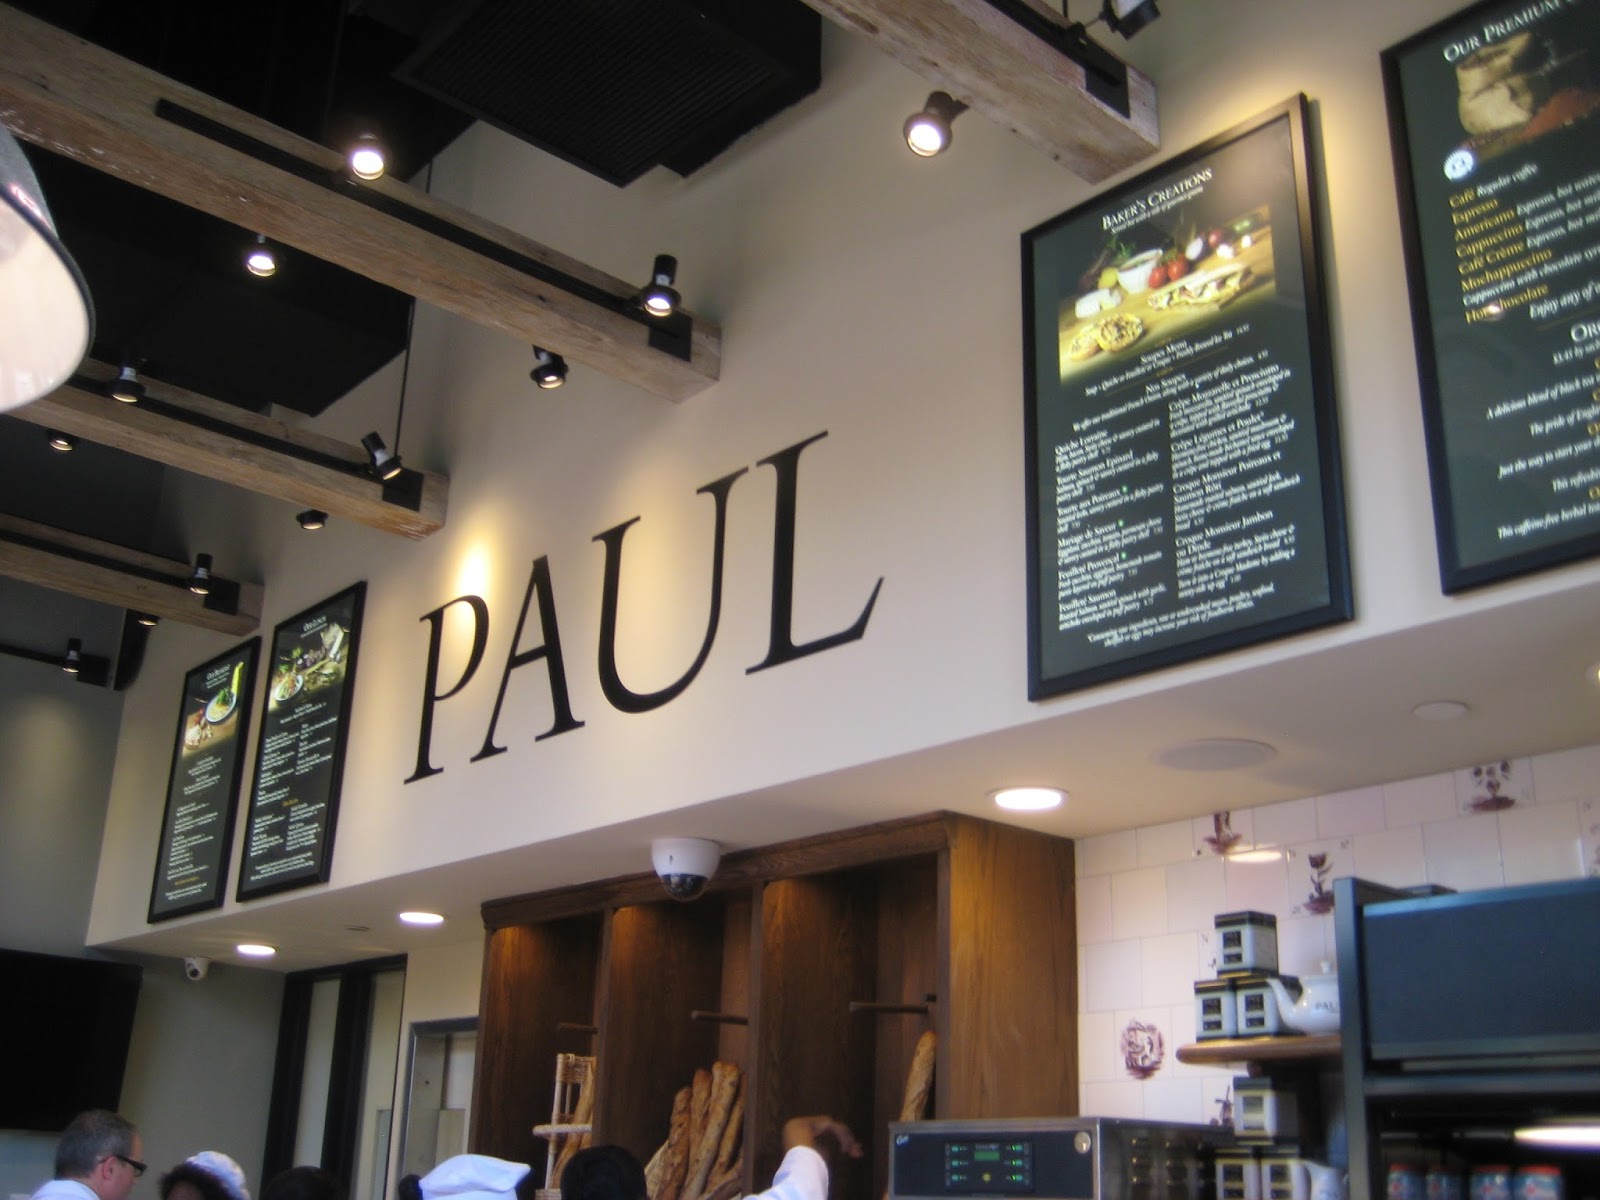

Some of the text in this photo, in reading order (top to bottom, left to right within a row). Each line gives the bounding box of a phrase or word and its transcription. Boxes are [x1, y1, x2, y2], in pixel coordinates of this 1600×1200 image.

[1442, 35, 1481, 62] OUR
[1102, 168, 1212, 229] BAKER'S CREATIONS
[1449, 190, 1474, 207] Café
[1452, 199, 1498, 224] Espresso
[1455, 210, 1514, 241] Americano
[1456, 225, 1522, 257] Cappuccino
[1458, 257, 1484, 274] Café
[1486, 242, 1523, 263] Crème
[1461, 251, 1551, 291] Mochappuccino
[1463, 280, 1515, 305] Cappuccino
[1516, 269, 1538, 285] with
[1488, 286, 1547, 315] hocolate
[1529, 299, 1558, 318] Enjoy
[1560, 291, 1580, 307] any
[1242, 510, 1273, 529] Jambon
[404, 430, 884, 785] PAUL
